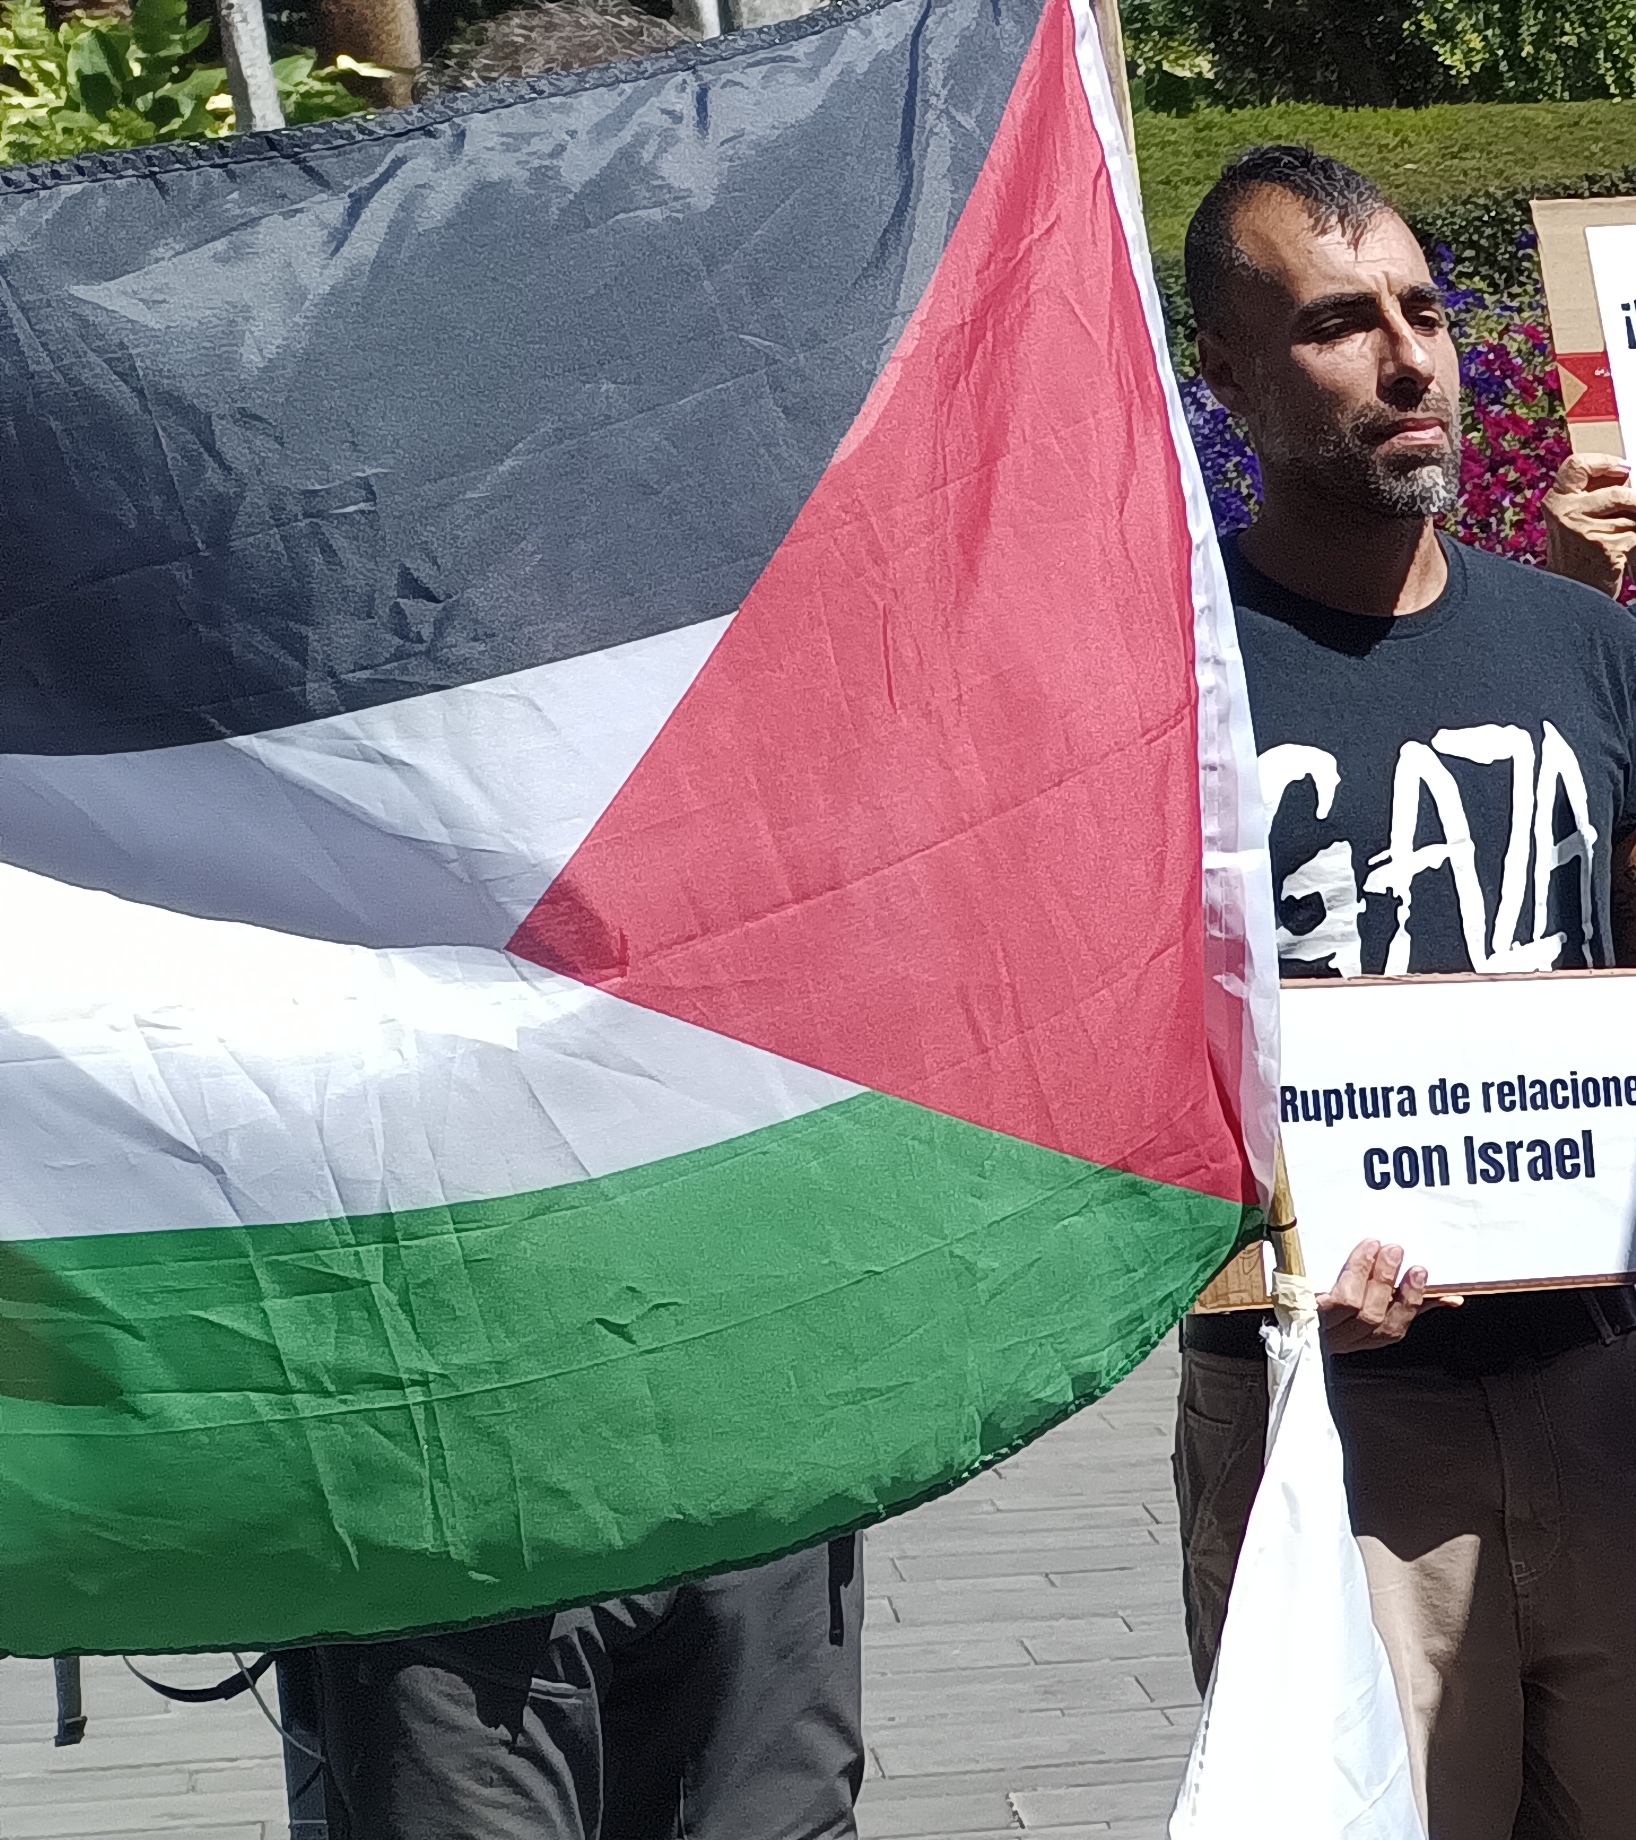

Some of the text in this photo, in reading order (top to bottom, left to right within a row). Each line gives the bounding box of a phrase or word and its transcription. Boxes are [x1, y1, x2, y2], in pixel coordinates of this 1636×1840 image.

[1257, 720, 1600, 980] GAZA
[1280, 1082, 1417, 1127] Ruptura
[1428, 1078, 1471, 1116] de
[1363, 1129, 1596, 1190] con Israel
